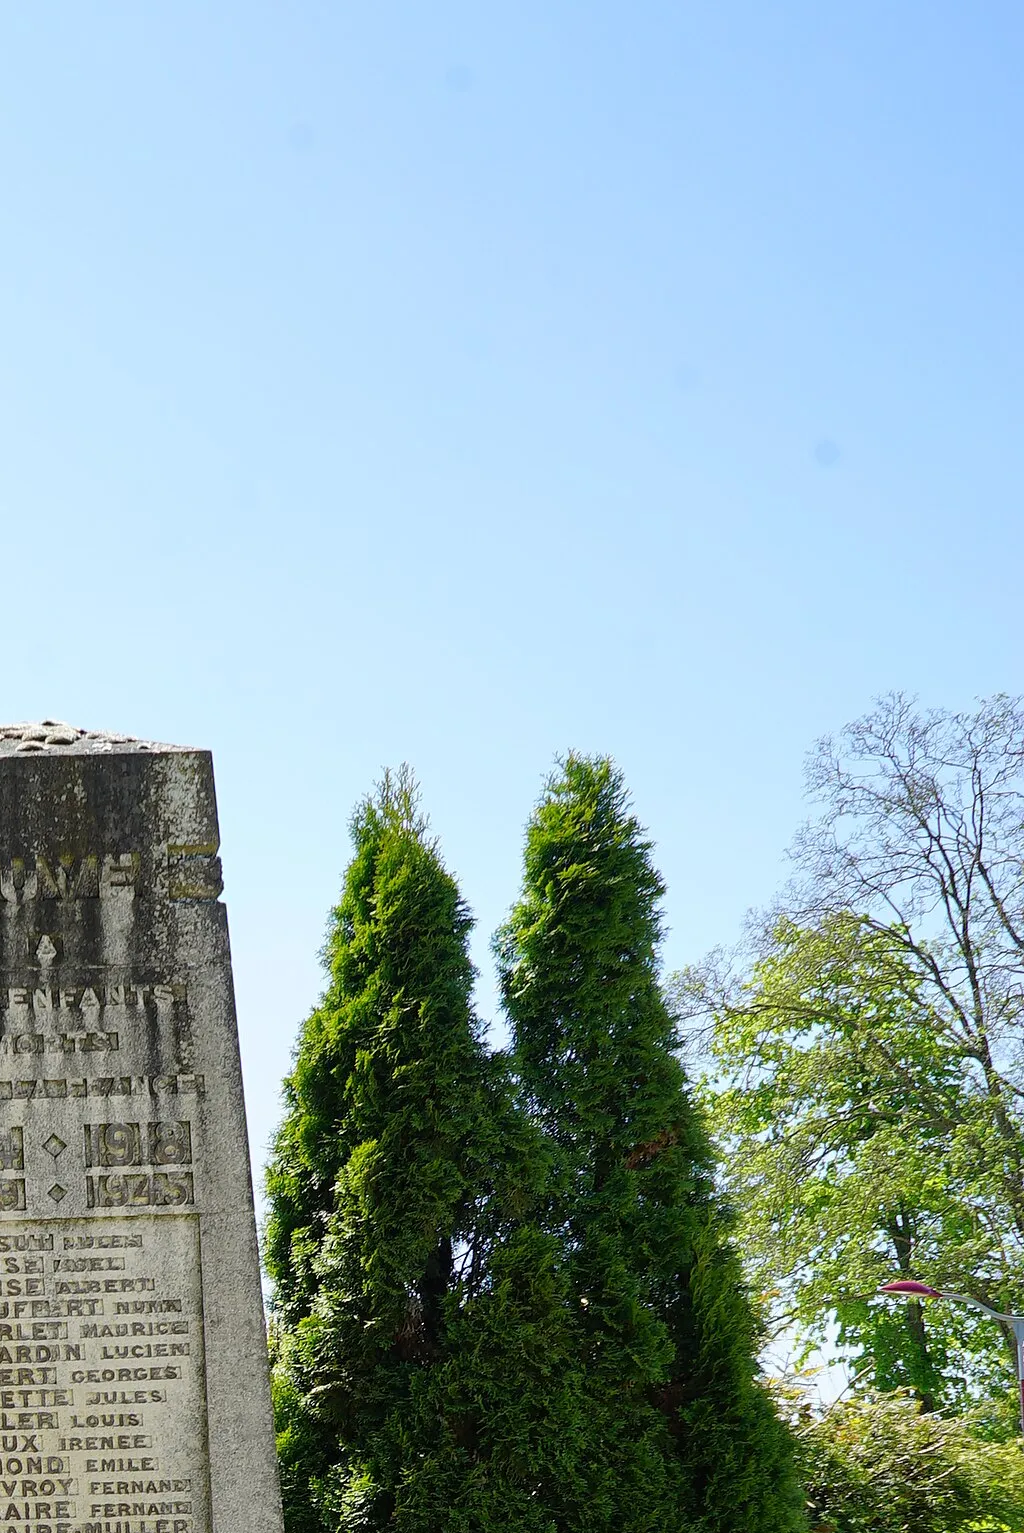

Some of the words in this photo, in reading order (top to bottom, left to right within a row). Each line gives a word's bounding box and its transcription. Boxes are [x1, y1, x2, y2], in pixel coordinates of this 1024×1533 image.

[35, 934, 57, 958] A
[9, 984, 175, 1010] ENFANTS
[11, 1079, 46, 1099] LA
[67, 1074, 198, 1098] FRANCE
[90, 1121, 192, 1168] 1918
[92, 1171, 189, 1208] 1945
[56, 1278, 151, 1295] ALBERT
[116, 1300, 182, 1315] NUMA
[80, 1322, 188, 1339] MAURICE
[102, 1343, 189, 1359] LUCIEN
[71, 1366, 177, 1383] GEORGES
[89, 1390, 163, 1405] JULES
[72, 1413, 140, 1428] LOUIS
[59, 1435, 147, 1451] IRENEE
[86, 1458, 155, 1472] EMILE
[90, 1479, 190, 1495] FERNAND
[91, 1501, 190, 1518] FERNAND
